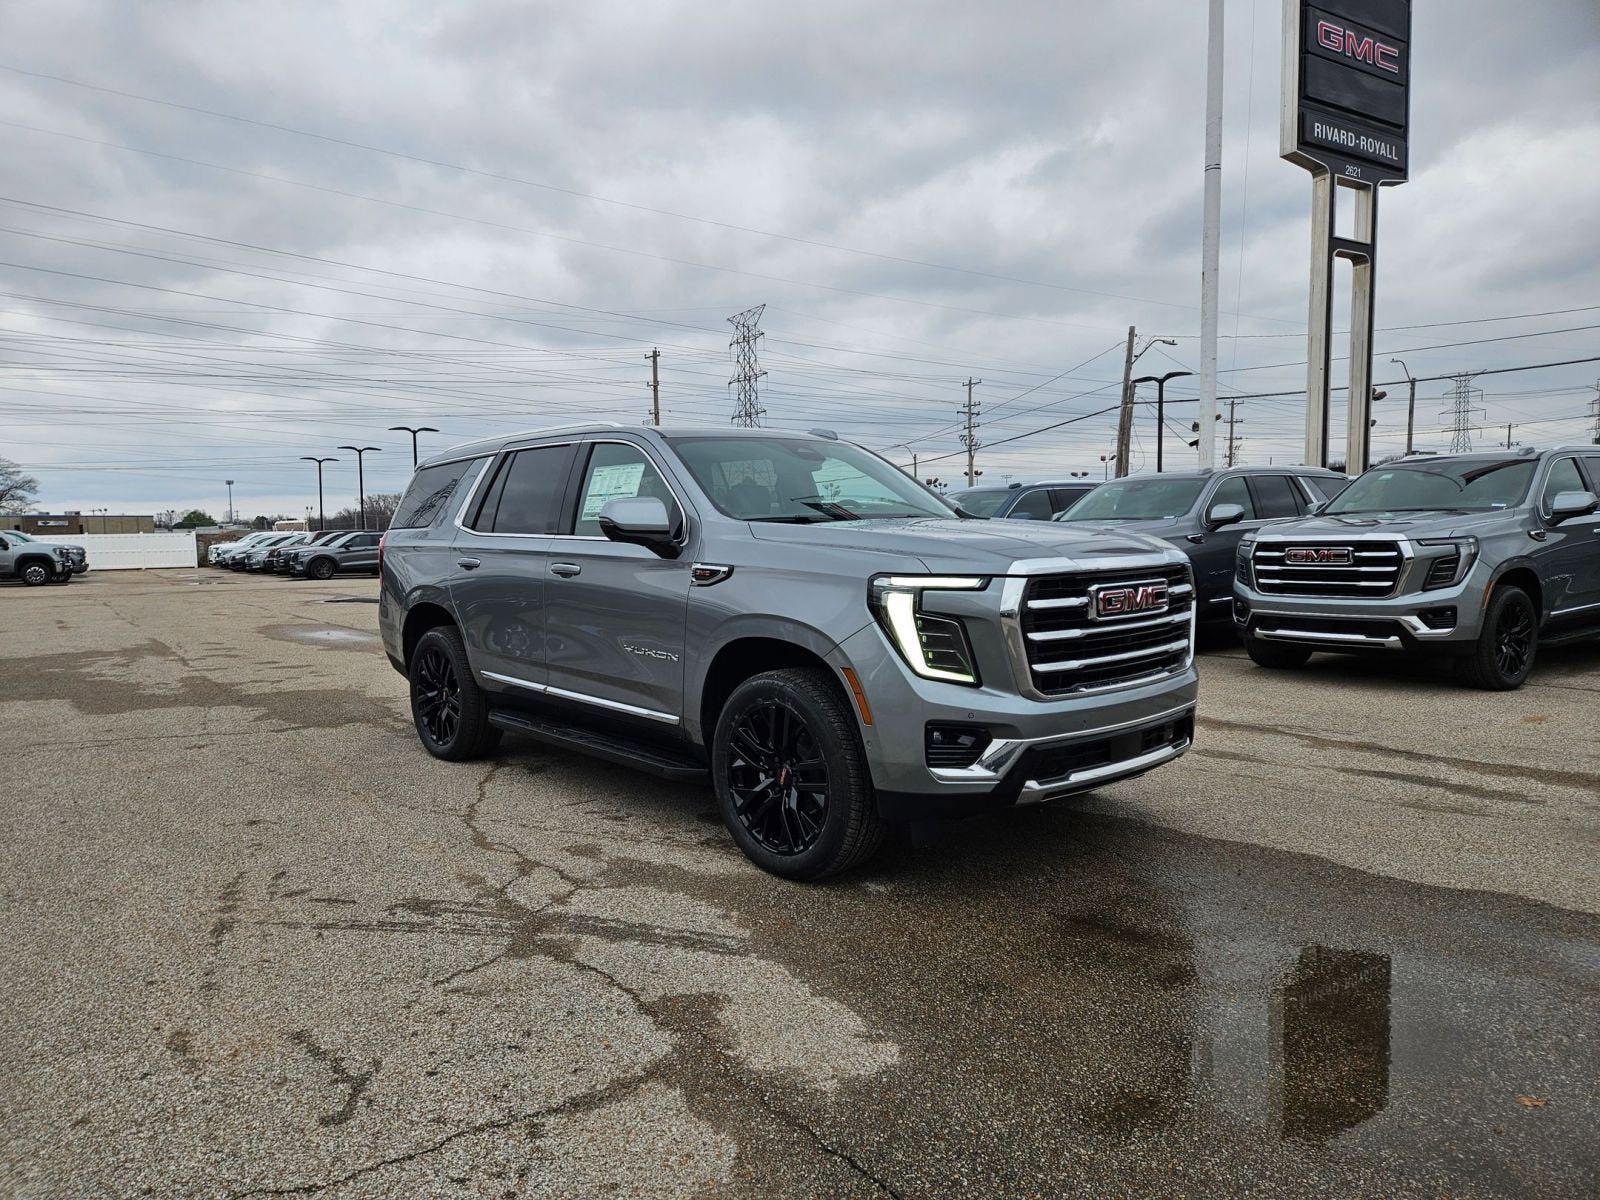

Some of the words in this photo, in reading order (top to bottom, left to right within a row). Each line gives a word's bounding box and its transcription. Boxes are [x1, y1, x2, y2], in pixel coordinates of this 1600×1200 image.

[1317, 20, 1399, 73] GMC
[1314, 122, 1398, 160] RIVARD-ROYALL
[1345, 164, 1361, 177] 2621
[1287, 549, 1348, 562] GMC
[1098, 585, 1168, 615] GMC
[623, 644, 679, 662] YUKON
